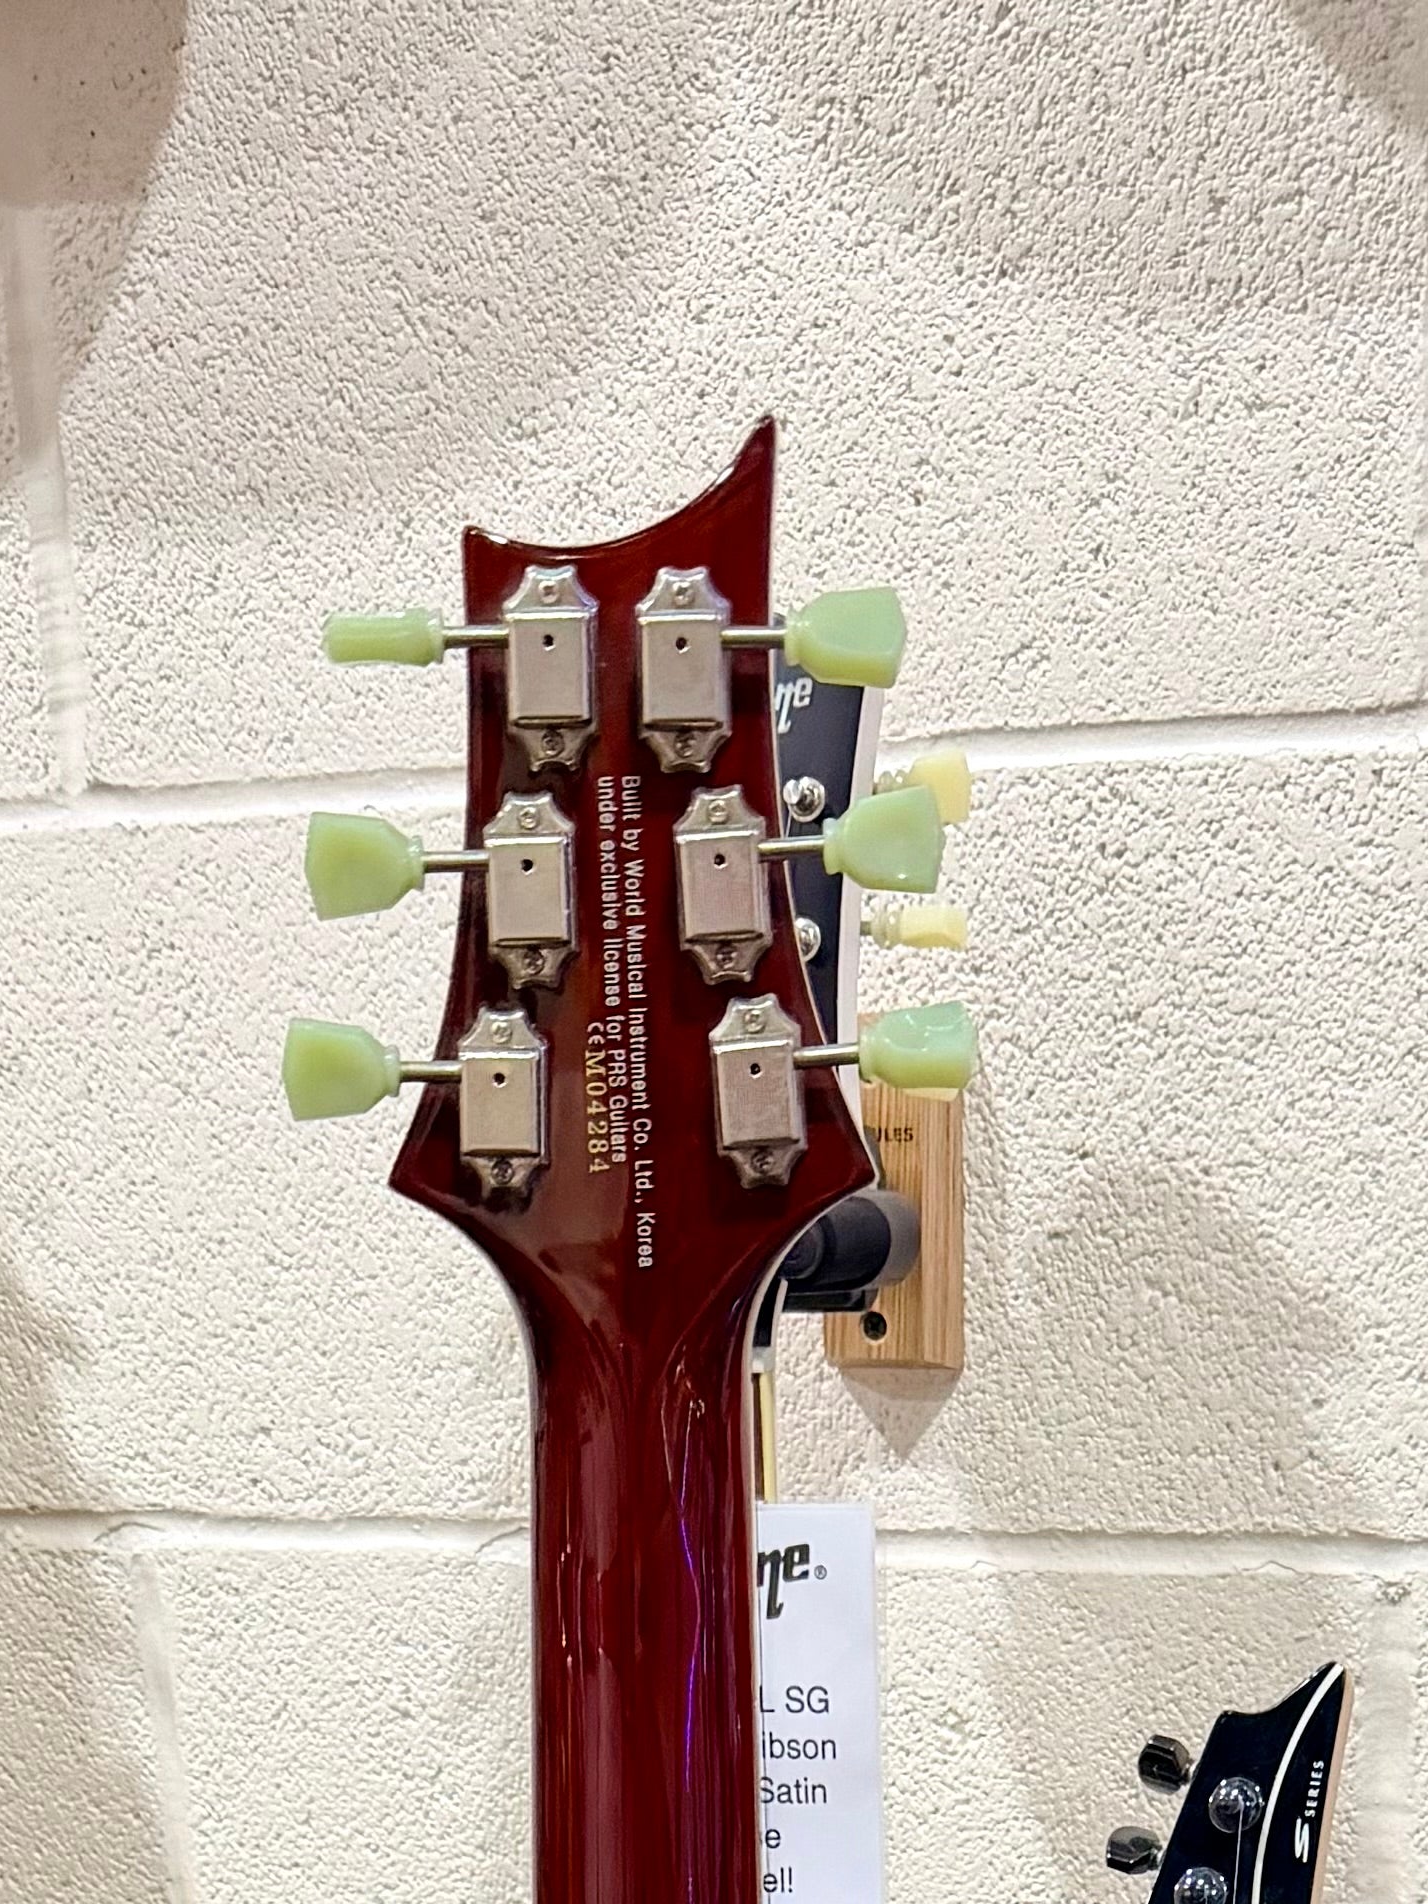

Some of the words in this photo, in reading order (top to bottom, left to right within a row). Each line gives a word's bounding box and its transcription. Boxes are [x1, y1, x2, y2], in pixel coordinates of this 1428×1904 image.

[775, 677, 813, 734] ne
[597, 776, 619, 832] under
[622, 776, 642, 821] Built
[621, 828, 644, 851] by
[600, 839, 622, 931] exclusive
[624, 859, 646, 917] World
[603, 937, 624, 1007] license
[626, 924, 648, 998] Musical
[605, 1014, 625, 1041] for
[607, 1049, 627, 1088] PRS
[628, 1007, 651, 1111] Instrument
[608, 1094, 630, 1163] Guitars
[633, 1118, 652, 1151] Co.
[636, 1212, 656, 1268] Korea
[757, 1543, 810, 1620] ne
[785, 1685, 830, 1714] SG
[762, 1731, 837, 1760] ibson
[1294, 1816, 1310, 1863] S
[1304, 1759, 1325, 1818] SERIES
[763, 1867, 793, 1893] el!
